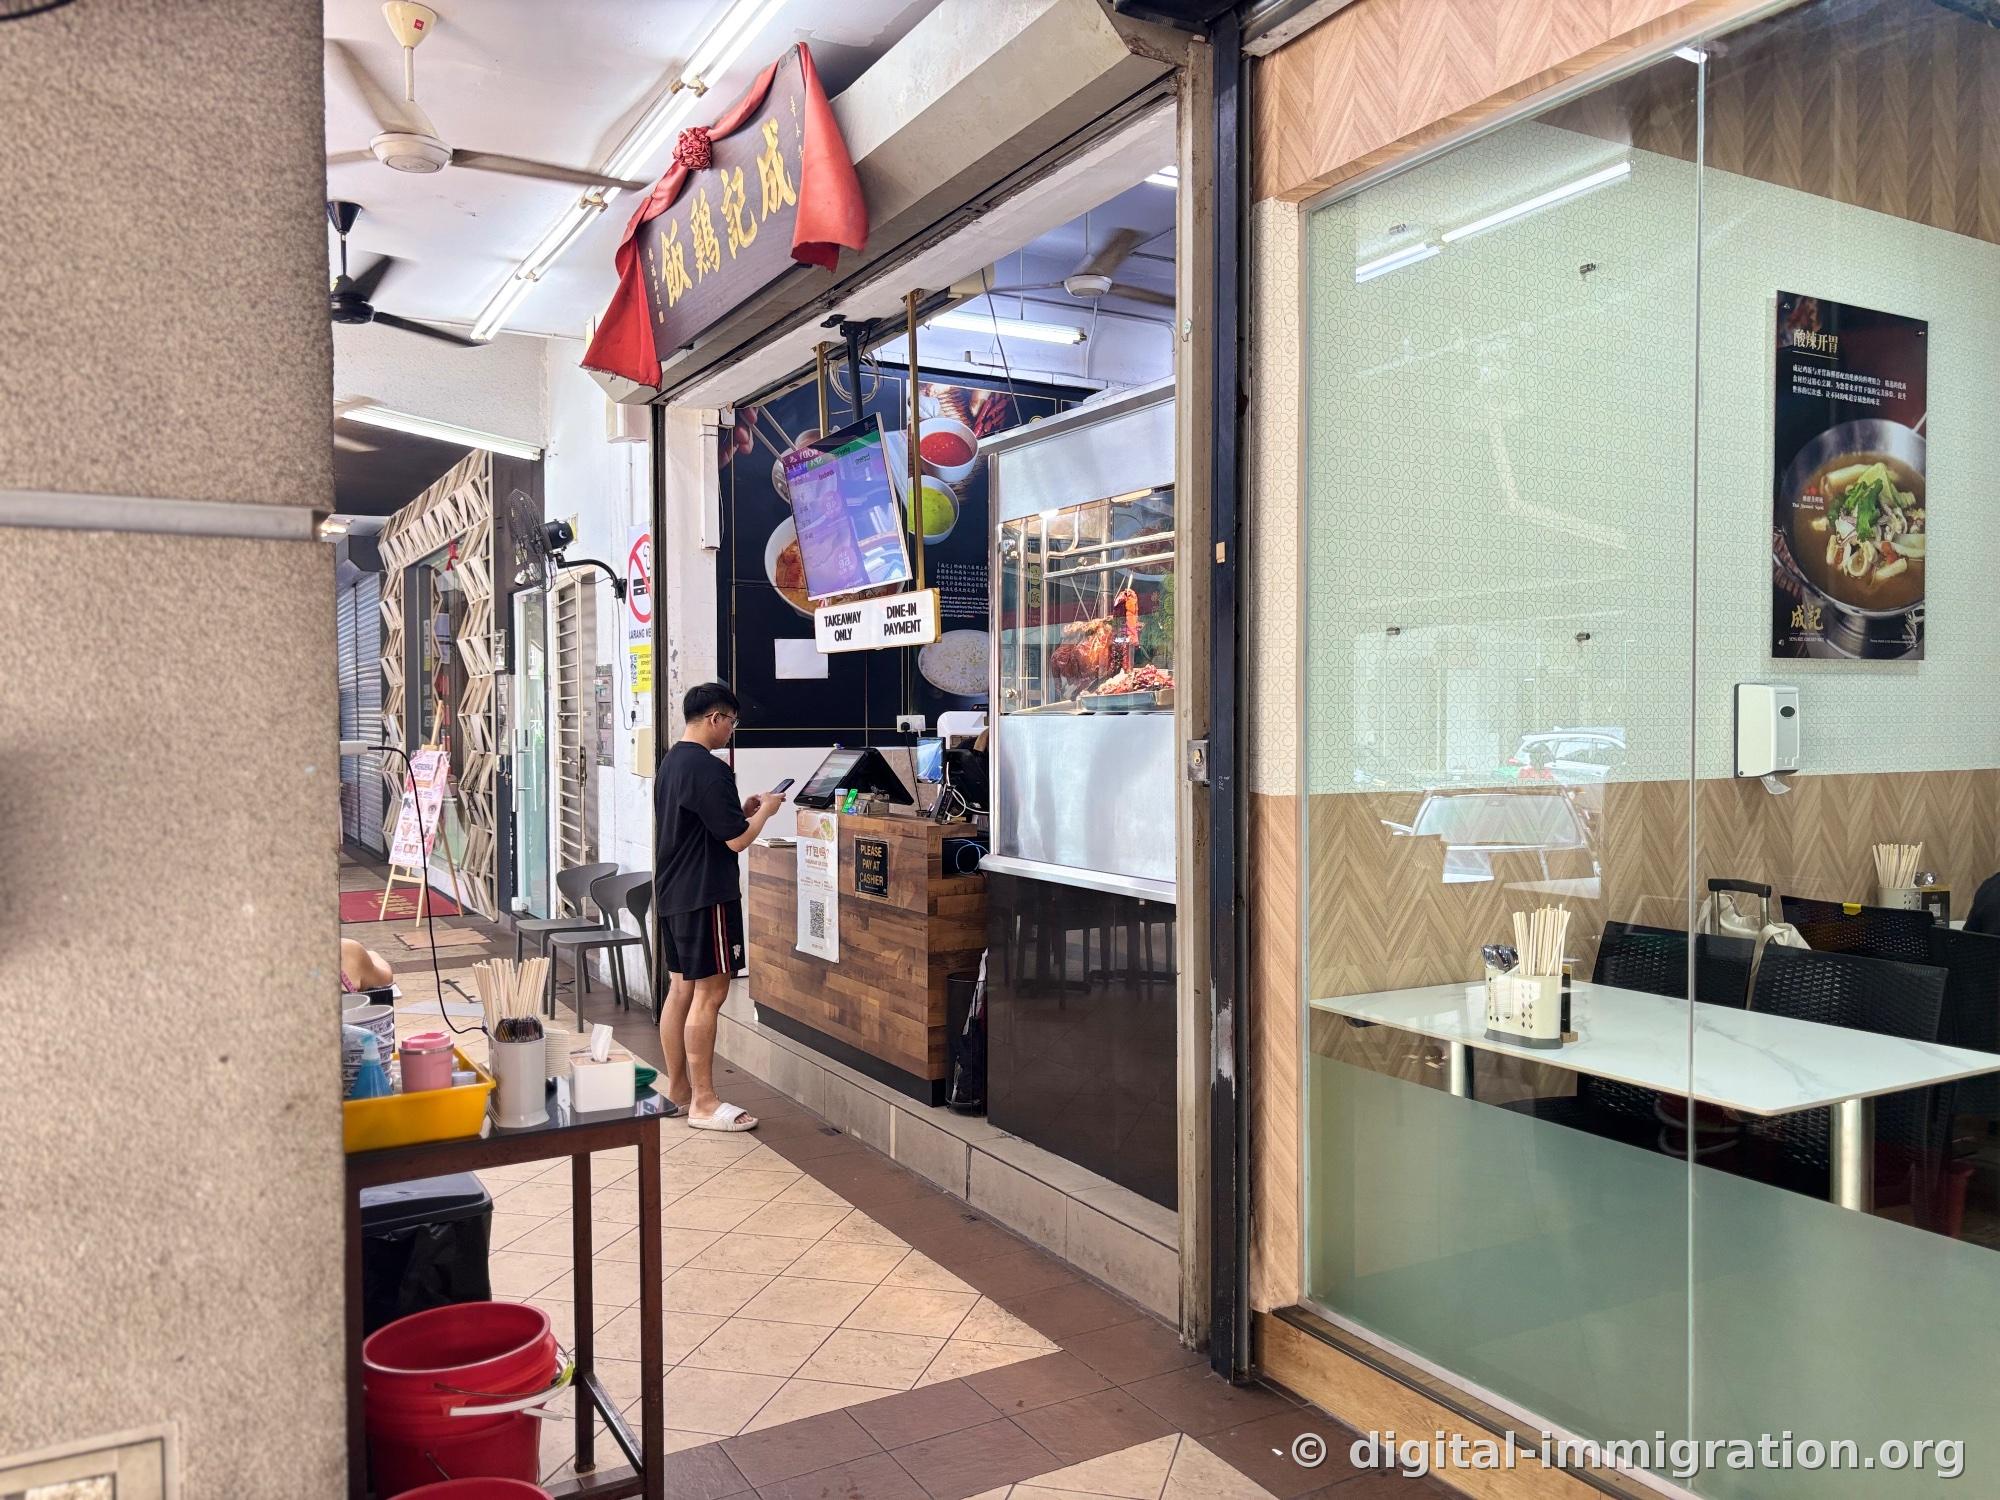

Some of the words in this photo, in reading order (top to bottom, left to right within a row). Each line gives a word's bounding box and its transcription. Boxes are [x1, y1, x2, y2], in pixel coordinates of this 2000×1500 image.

[1793, 329, 1839, 353] 酸辣开胃
[886, 602, 917, 619] DINE-IN
[1790, 604, 1824, 631] 成記
[824, 611, 861, 627] TAKEAWAY
[834, 628, 852, 641] ONLY
[884, 619, 921, 636] PAYMENT
[860, 844, 882, 857] PLEASE
[862, 859, 872, 870] PAY
[873, 861, 880, 871] AT
[860, 872, 883, 886] CASHIER
